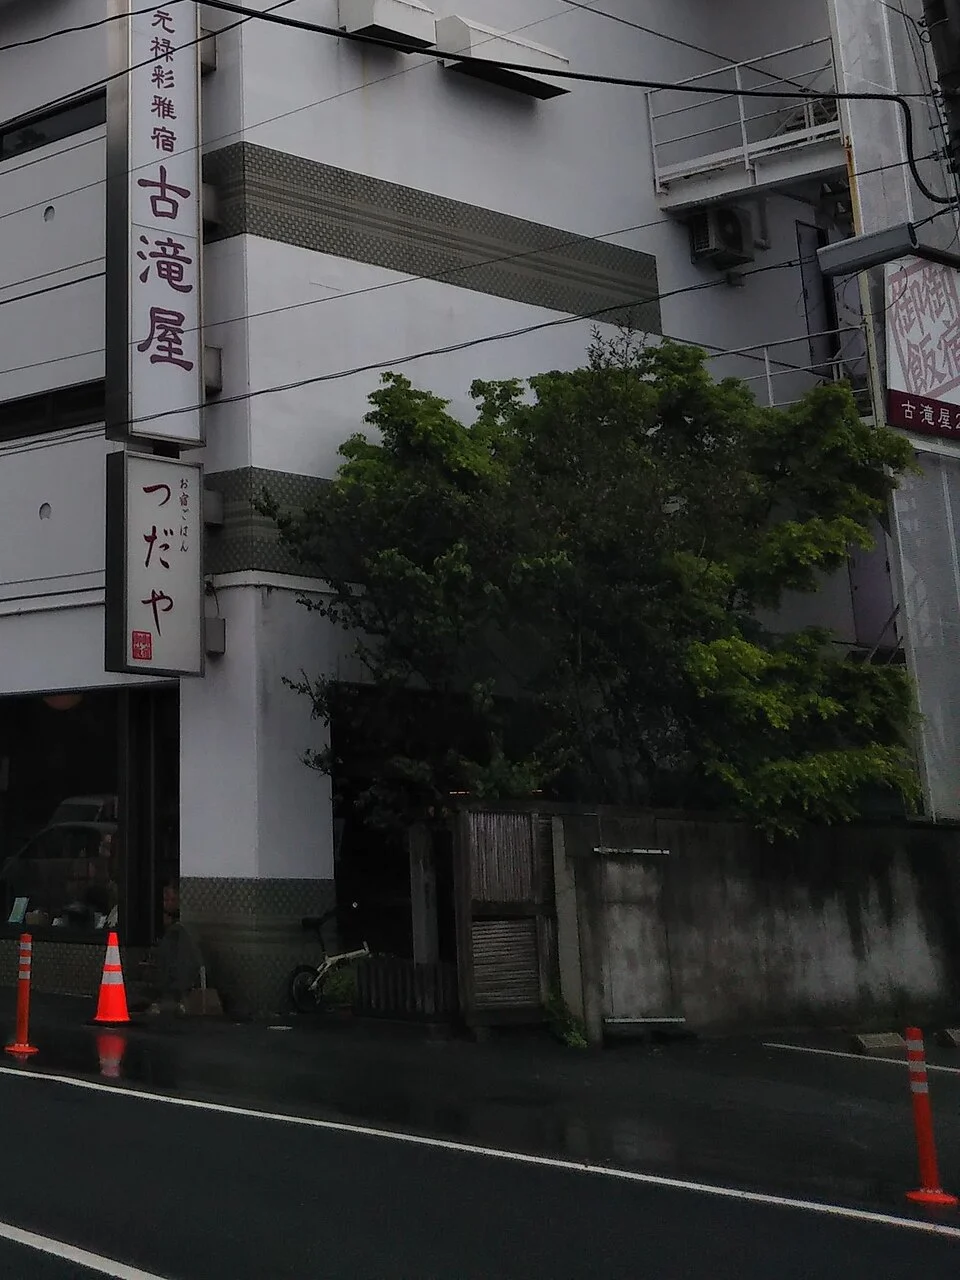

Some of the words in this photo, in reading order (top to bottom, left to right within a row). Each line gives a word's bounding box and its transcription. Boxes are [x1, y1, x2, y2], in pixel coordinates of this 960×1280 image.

[150, 9, 178, 153] 元禄彩雅宿
[137, 164, 195, 372] 古滝屋
[141, 483, 174, 637] つだや
[178, 478, 189, 552] お宿ごはん
